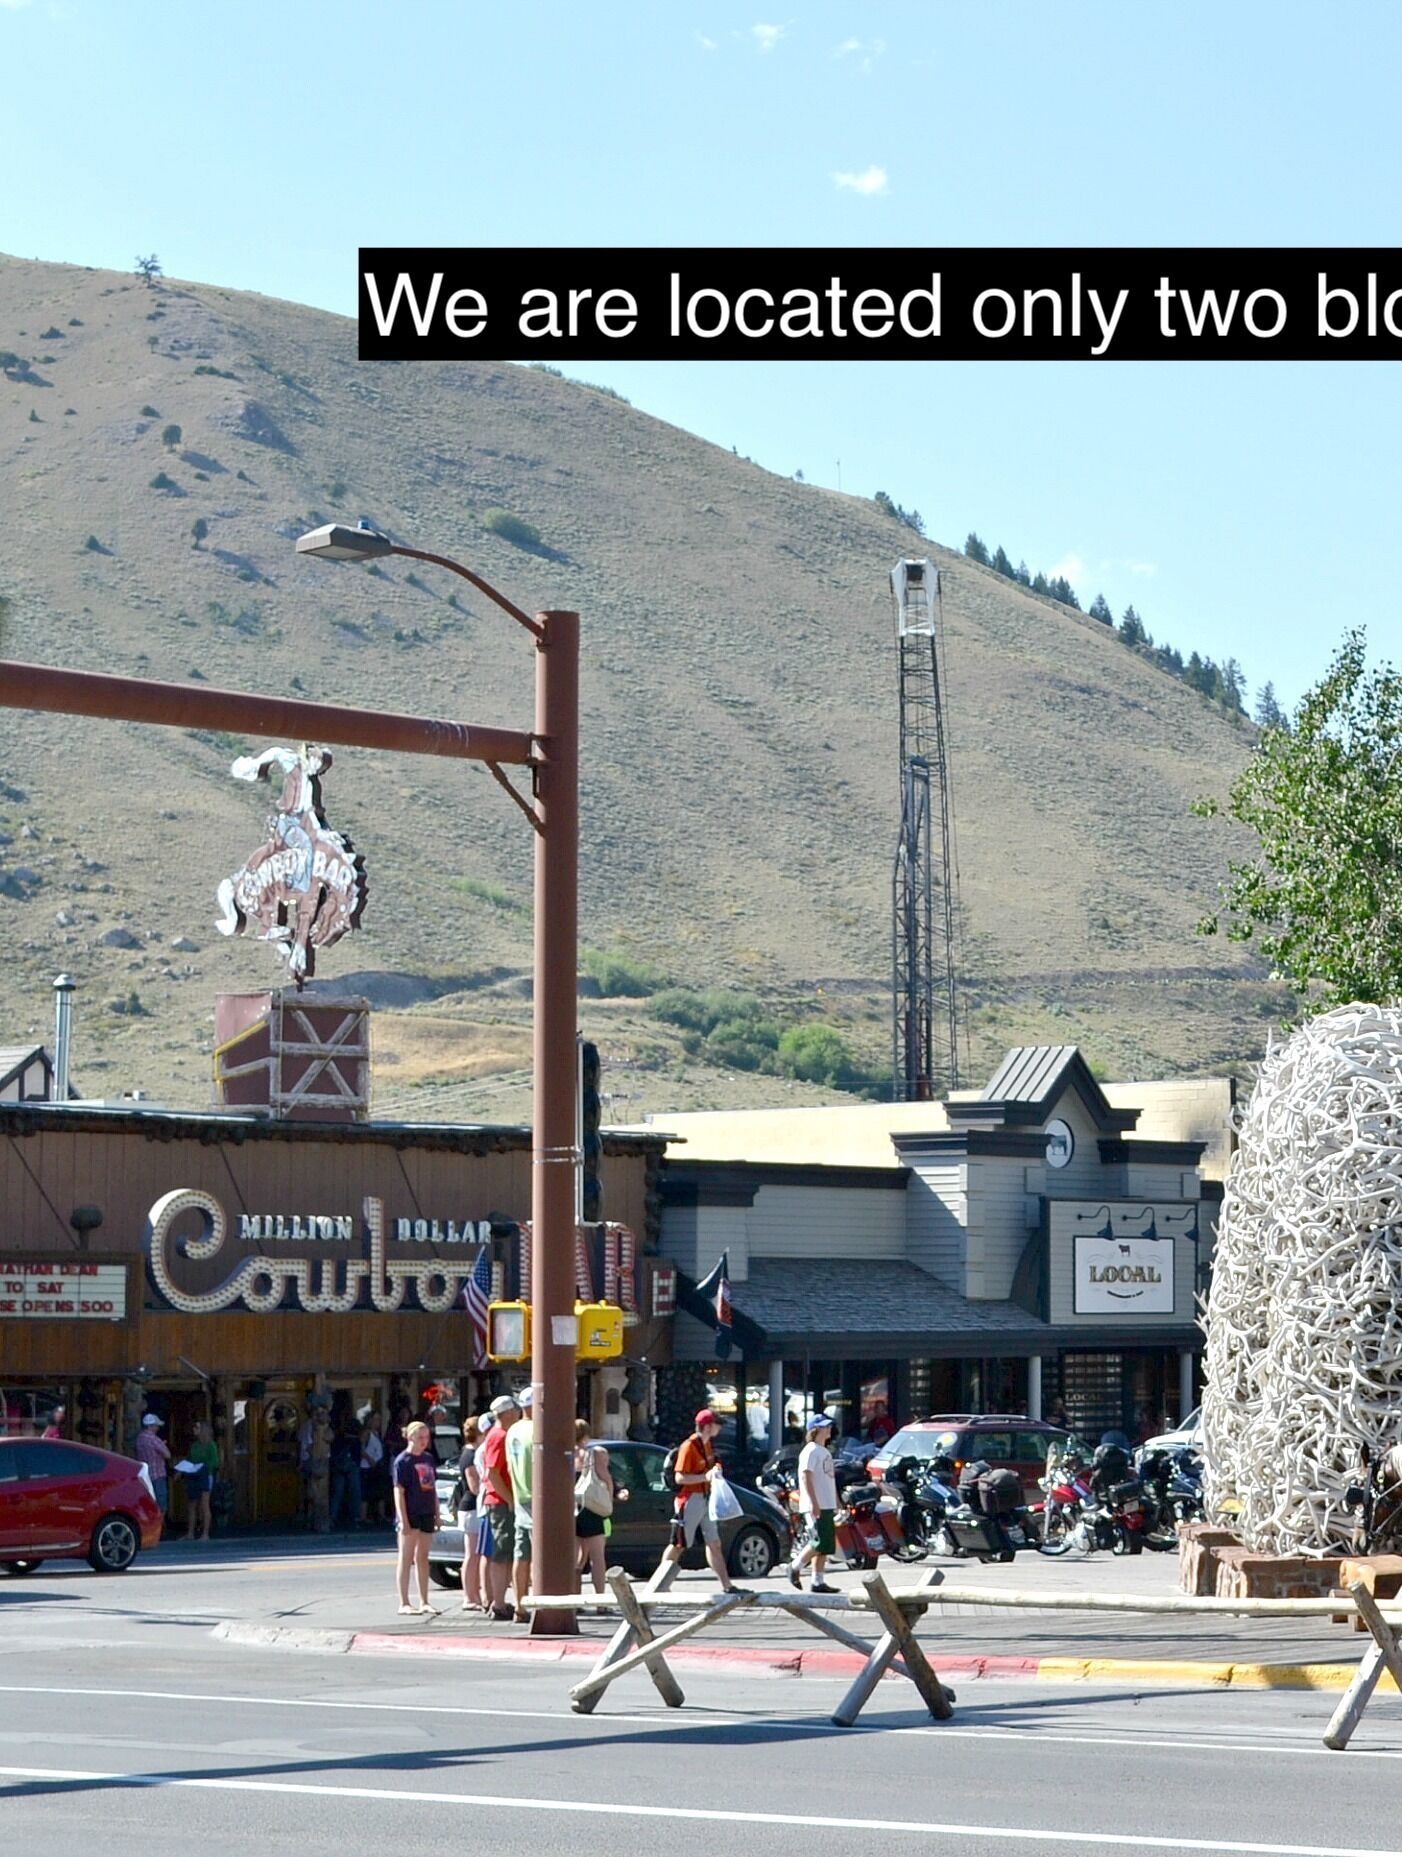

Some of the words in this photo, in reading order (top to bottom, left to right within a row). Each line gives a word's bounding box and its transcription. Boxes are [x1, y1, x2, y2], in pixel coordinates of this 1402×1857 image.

[240, 1214, 353, 1240] MILLION
[397, 1217, 492, 1243] DOLLAR
[1088, 1264, 1162, 1283] LOCAL
[5, 1282, 24, 1293] TO
[37, 1282, 65, 1294] SAT
[22, 1300, 74, 1313] OPENS
